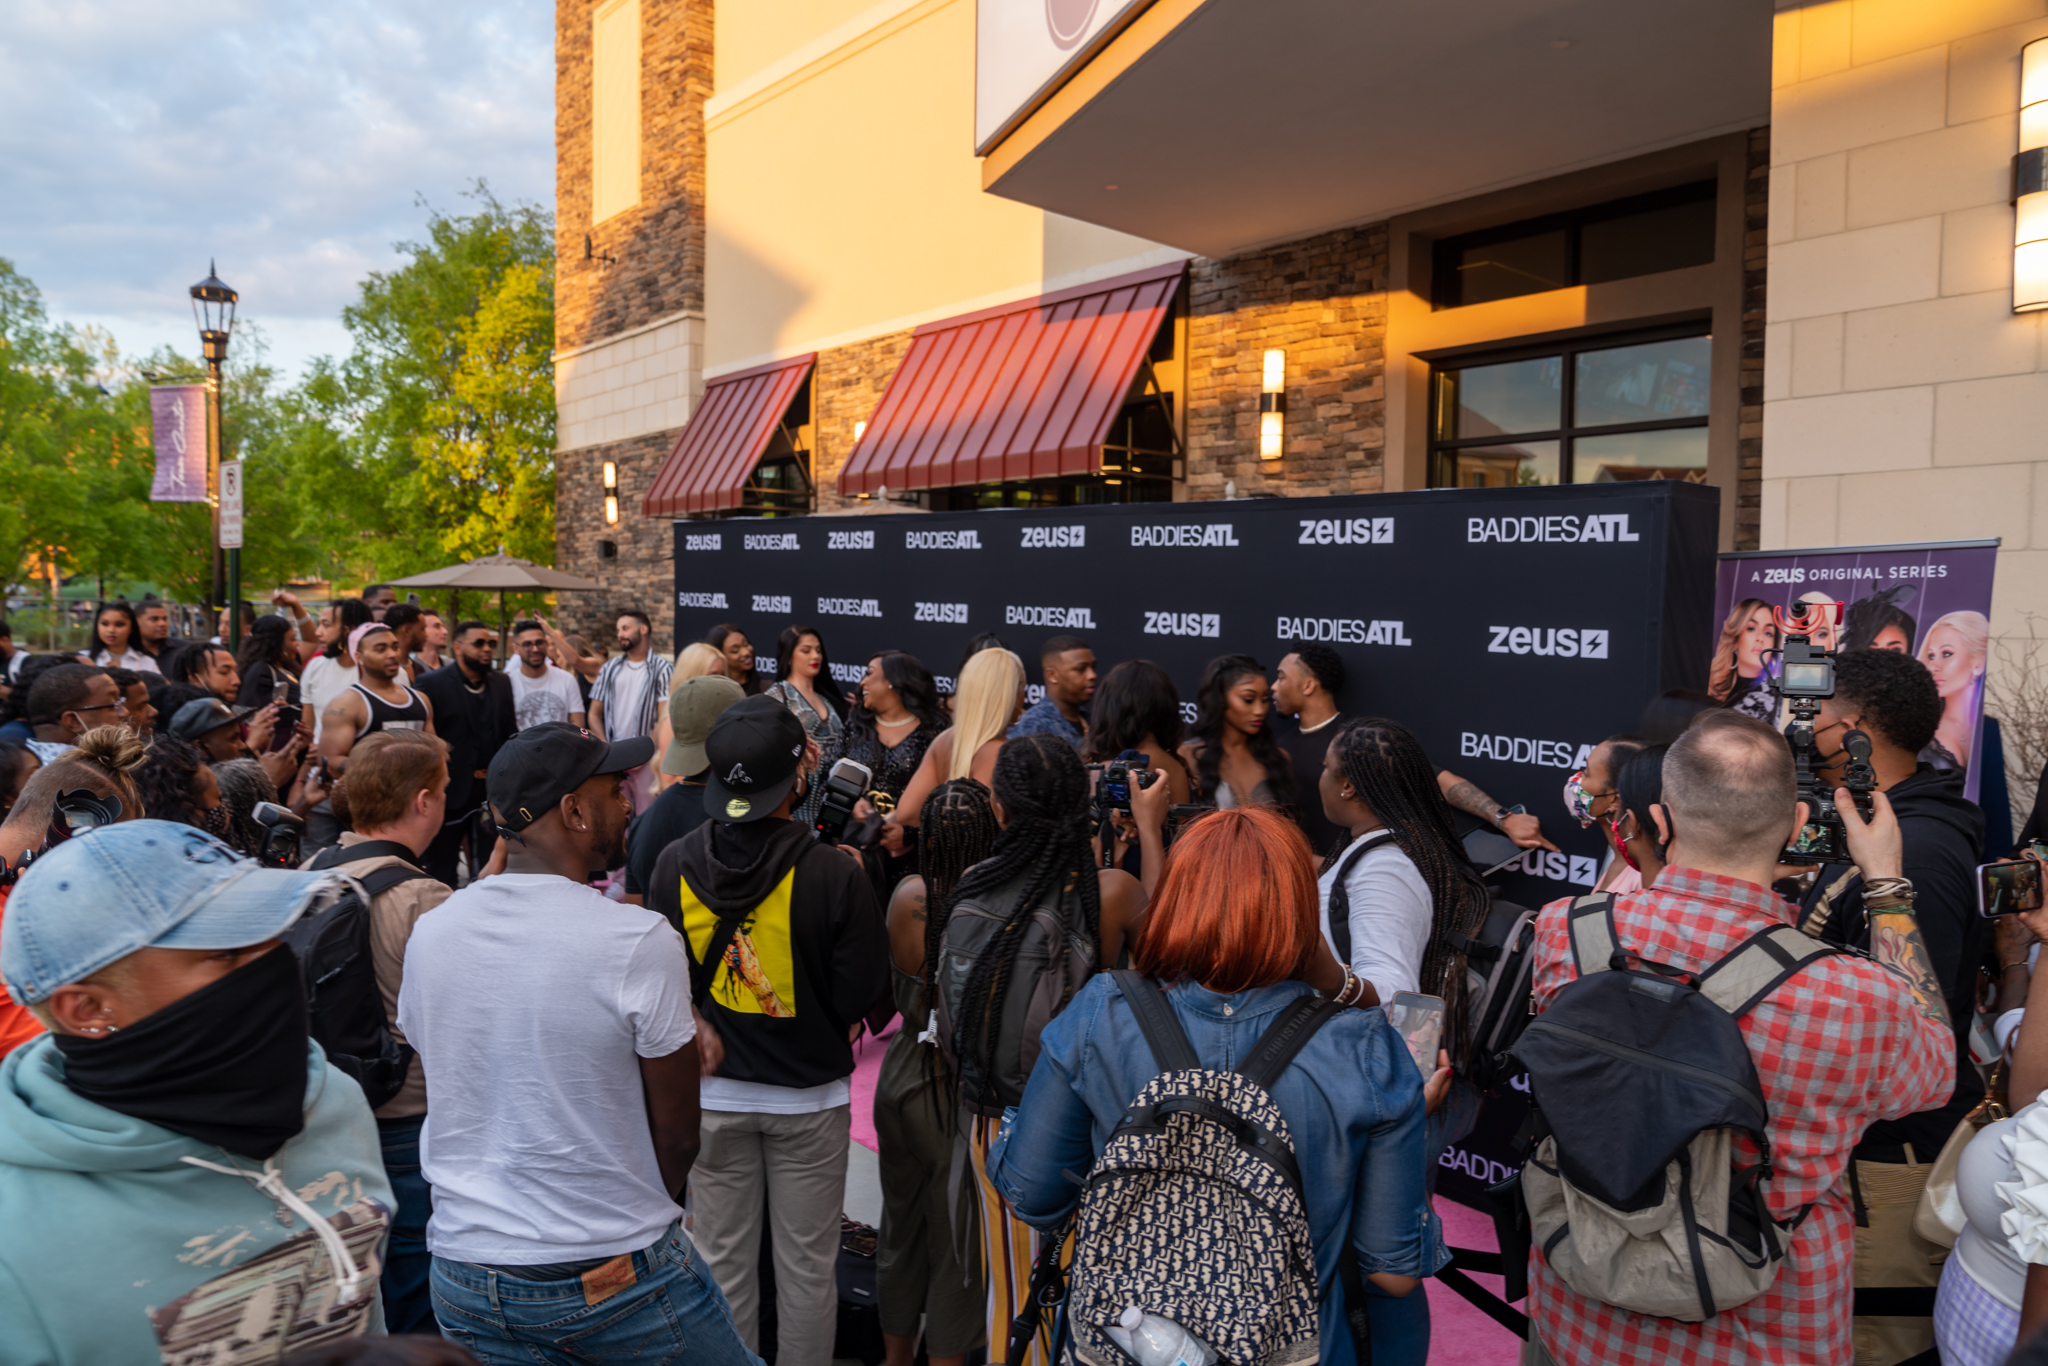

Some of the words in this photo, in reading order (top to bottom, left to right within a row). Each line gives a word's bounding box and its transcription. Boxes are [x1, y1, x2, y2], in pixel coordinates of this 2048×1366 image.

[1021, 526, 1069, 547] zeus
[1131, 524, 1239, 546] BADDIESATL
[1299, 519, 1370, 544] zeus
[1468, 514, 1639, 542] BADDIESATL
[686, 535, 712, 550] zeus
[745, 534, 800, 550] BADDIESATL
[828, 531, 862, 549] zeus
[906, 530, 982, 549] BADDIESATL
[1751, 571, 1760, 582] A
[1764, 568, 1805, 584] zeus
[1809, 567, 1883, 581] ORIGINAL
[1889, 565, 1948, 578] SERIES
[680, 592, 728, 608] BADDIESATL
[752, 595, 781, 612] zeus
[818, 598, 882, 617] BADDIESATL
[915, 602, 954, 622] zeus
[1006, 606, 1096, 629] BADDIESATL
[1144, 612, 1201, 636] zeus
[1278, 617, 1411, 646] BADDIESATL
[1488, 626, 1579, 657] zeus
[1263, 1007, 1315, 1063] CHRISTIAN
